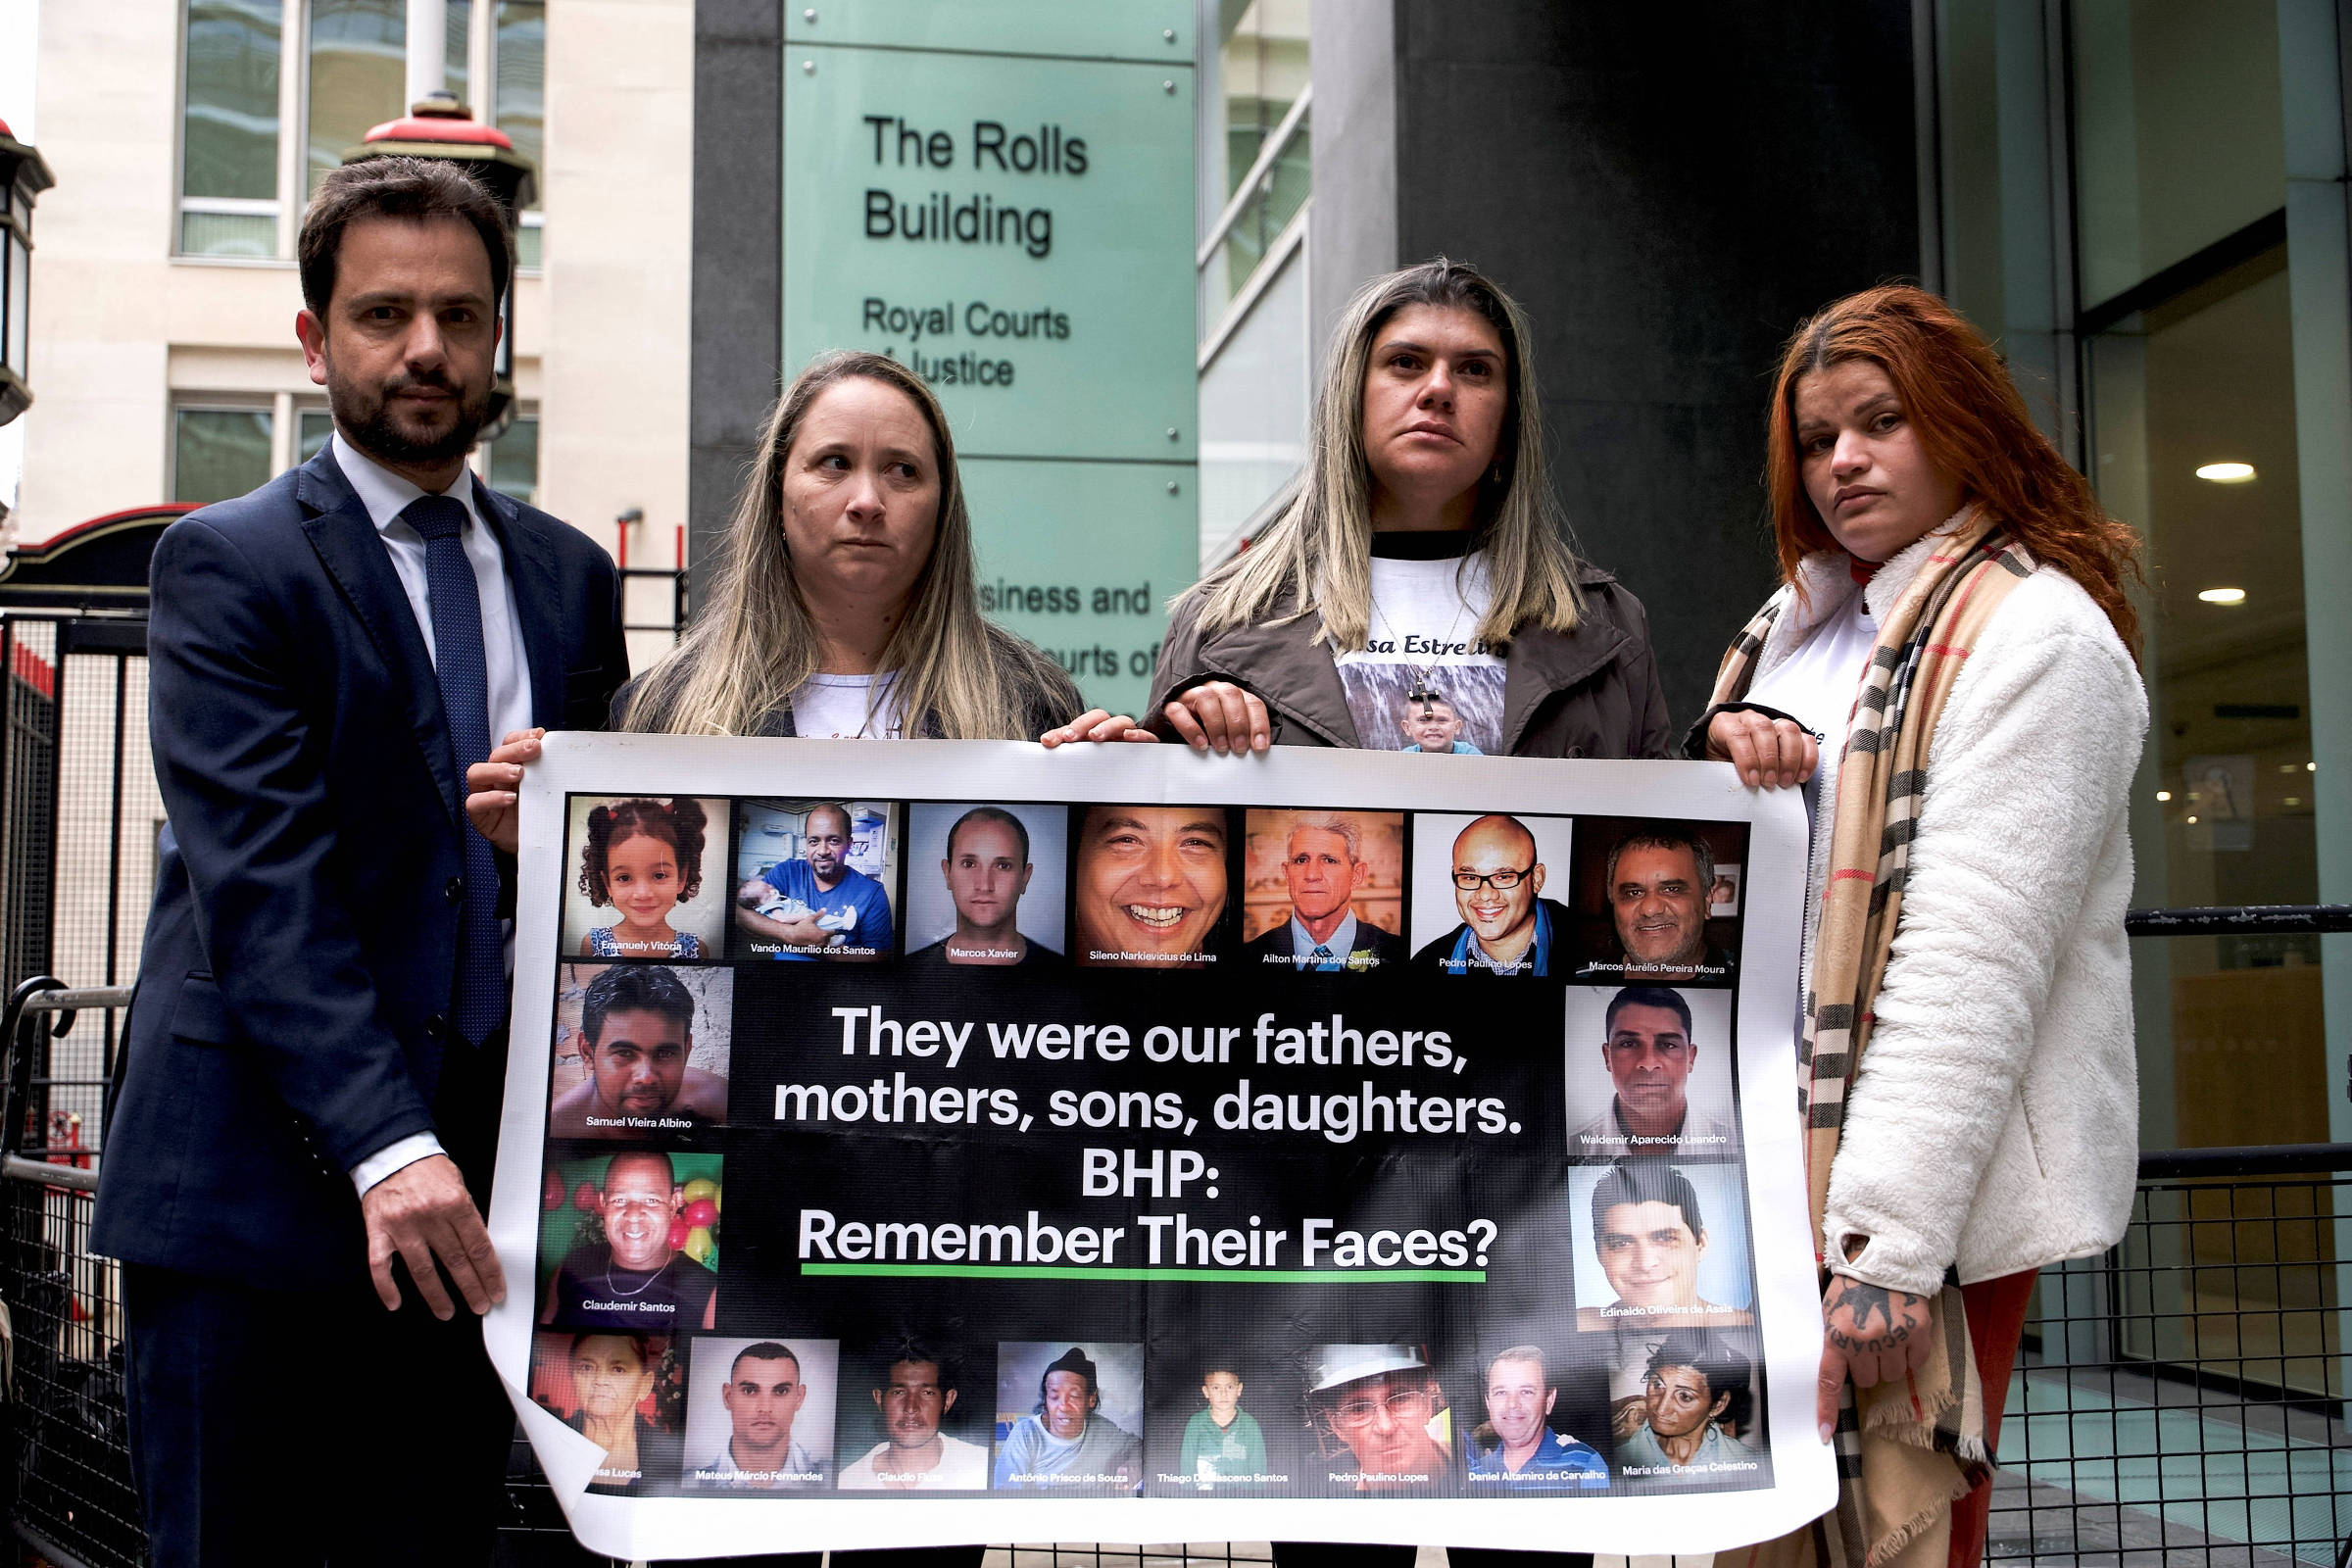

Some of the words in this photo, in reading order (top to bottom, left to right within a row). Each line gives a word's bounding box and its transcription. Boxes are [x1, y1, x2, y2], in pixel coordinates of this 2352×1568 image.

[862, 115, 955, 168] The
[974, 122, 1089, 174] Rolls
[864, 189, 1054, 259] Building
[862, 298, 954, 342] Royal
[964, 301, 1071, 340] Courts
[979, 578, 1082, 613] siness
[1091, 580, 1152, 615] and
[601, 940, 650, 952] Emanuely
[650, 940, 682, 951] Vitória
[750, 943, 781, 954] Vando
[783, 943, 821, 955] Maurílio
[822, 945, 842, 956] dos
[843, 945, 876, 956] Santos
[950, 948, 987, 958] Marcos
[987, 949, 1018, 959] Xavier
[1089, 951, 1119, 960] Sileno
[1120, 951, 1178, 961] Narkievicius
[1179, 952, 1193, 961] de
[1194, 953, 1217, 962] Lima
[1262, 954, 1291, 963] Ailton
[1292, 954, 1328, 964] Martins
[1329, 955, 1348, 965] dos
[1348, 956, 1380, 965] Santos
[1439, 957, 1467, 968] Pedro
[1468, 958, 1502, 968] Paulino
[1504, 959, 1533, 971] Lopes
[1589, 961, 1624, 971] Marcos
[1624, 962, 1659, 972] Aurélio
[1660, 963, 1693, 973] Pereira
[1694, 964, 1726, 975] Moura
[831, 1004, 975, 1067] They
[986, 1021, 1130, 1061] were
[1143, 1025, 1241, 1063] our
[1252, 1012, 1468, 1075] fathers,
[774, 1071, 1034, 1133] mothers,
[1049, 1089, 1199, 1137] sons,
[1213, 1078, 1522, 1144] daughters.
[586, 1116, 626, 1127] Samuel
[627, 1117, 658, 1128] Vieira
[658, 1118, 692, 1128] Albino
[1580, 1134, 1630, 1145] Waldemir
[1630, 1134, 1684, 1146] Aparecido
[1685, 1135, 1728, 1145] Leandro
[1082, 1148, 1219, 1199] BHP:
[798, 1209, 1125, 1264] Remember
[1137, 1213, 1287, 1266] Their
[1302, 1218, 1498, 1267] Faces?
[582, 1299, 638, 1311] Claudemir
[639, 1301, 676, 1312] Santos
[1599, 1306, 1646, 1318] Edinaldo
[1646, 1305, 1689, 1315] Oliveira
[1690, 1304, 1705, 1314] de
[1704, 1303, 1734, 1314] Assis
[612, 1467, 643, 1479] Lucas
[1622, 1465, 1651, 1476] Maria
[1652, 1464, 1672, 1475] das
[1708, 1460, 1758, 1472] Celestino
[695, 1470, 733, 1481] Mateus
[734, 1469, 769, 1481] Márcio
[770, 1471, 824, 1482] Fernandes
[1008, 1471, 1049, 1483] Antônio
[1050, 1472, 1081, 1483] Prisco
[1082, 1472, 1097, 1483] de
[1097, 1473, 1129, 1483] Souza
[1156, 1473, 1192, 1485] Thiago
[1193, 1473, 1252, 1483] Dasceno
[1253, 1473, 1289, 1483] Santos
[1328, 1472, 1358, 1483] Pedro
[1359, 1472, 1397, 1483] Paulino
[1397, 1472, 1429, 1484] Lopes
[1468, 1471, 1500, 1482] Daniel
[1501, 1471, 1544, 1482] Altamiro
[1545, 1471, 1560, 1481] de
[1560, 1470, 1606, 1481] Carvalho
